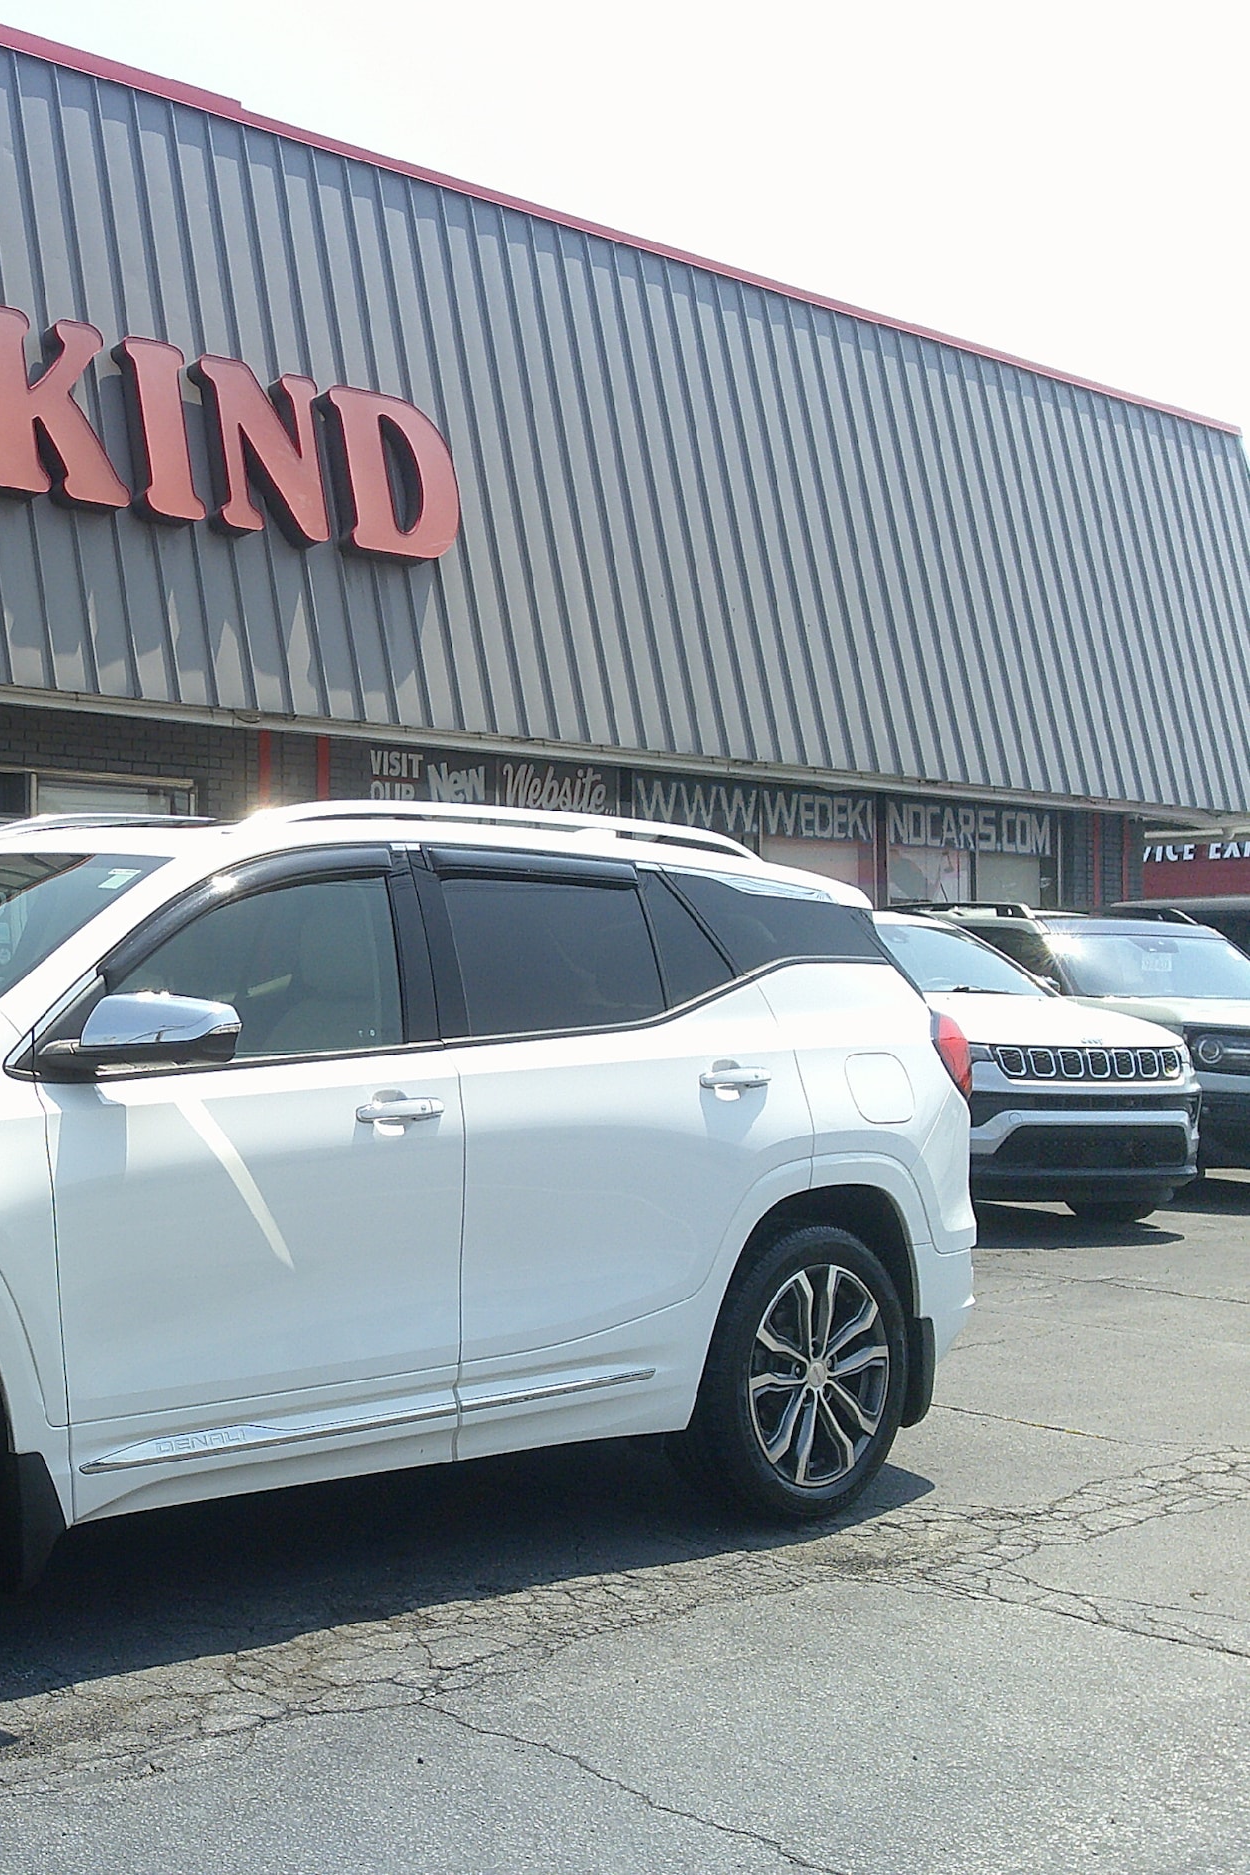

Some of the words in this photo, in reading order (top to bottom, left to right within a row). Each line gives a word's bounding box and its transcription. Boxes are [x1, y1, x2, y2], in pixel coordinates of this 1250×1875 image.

[370, 749, 423, 778] VISIT
[427, 762, 486, 803] New
[156, 1429, 247, 1453] DENALI
